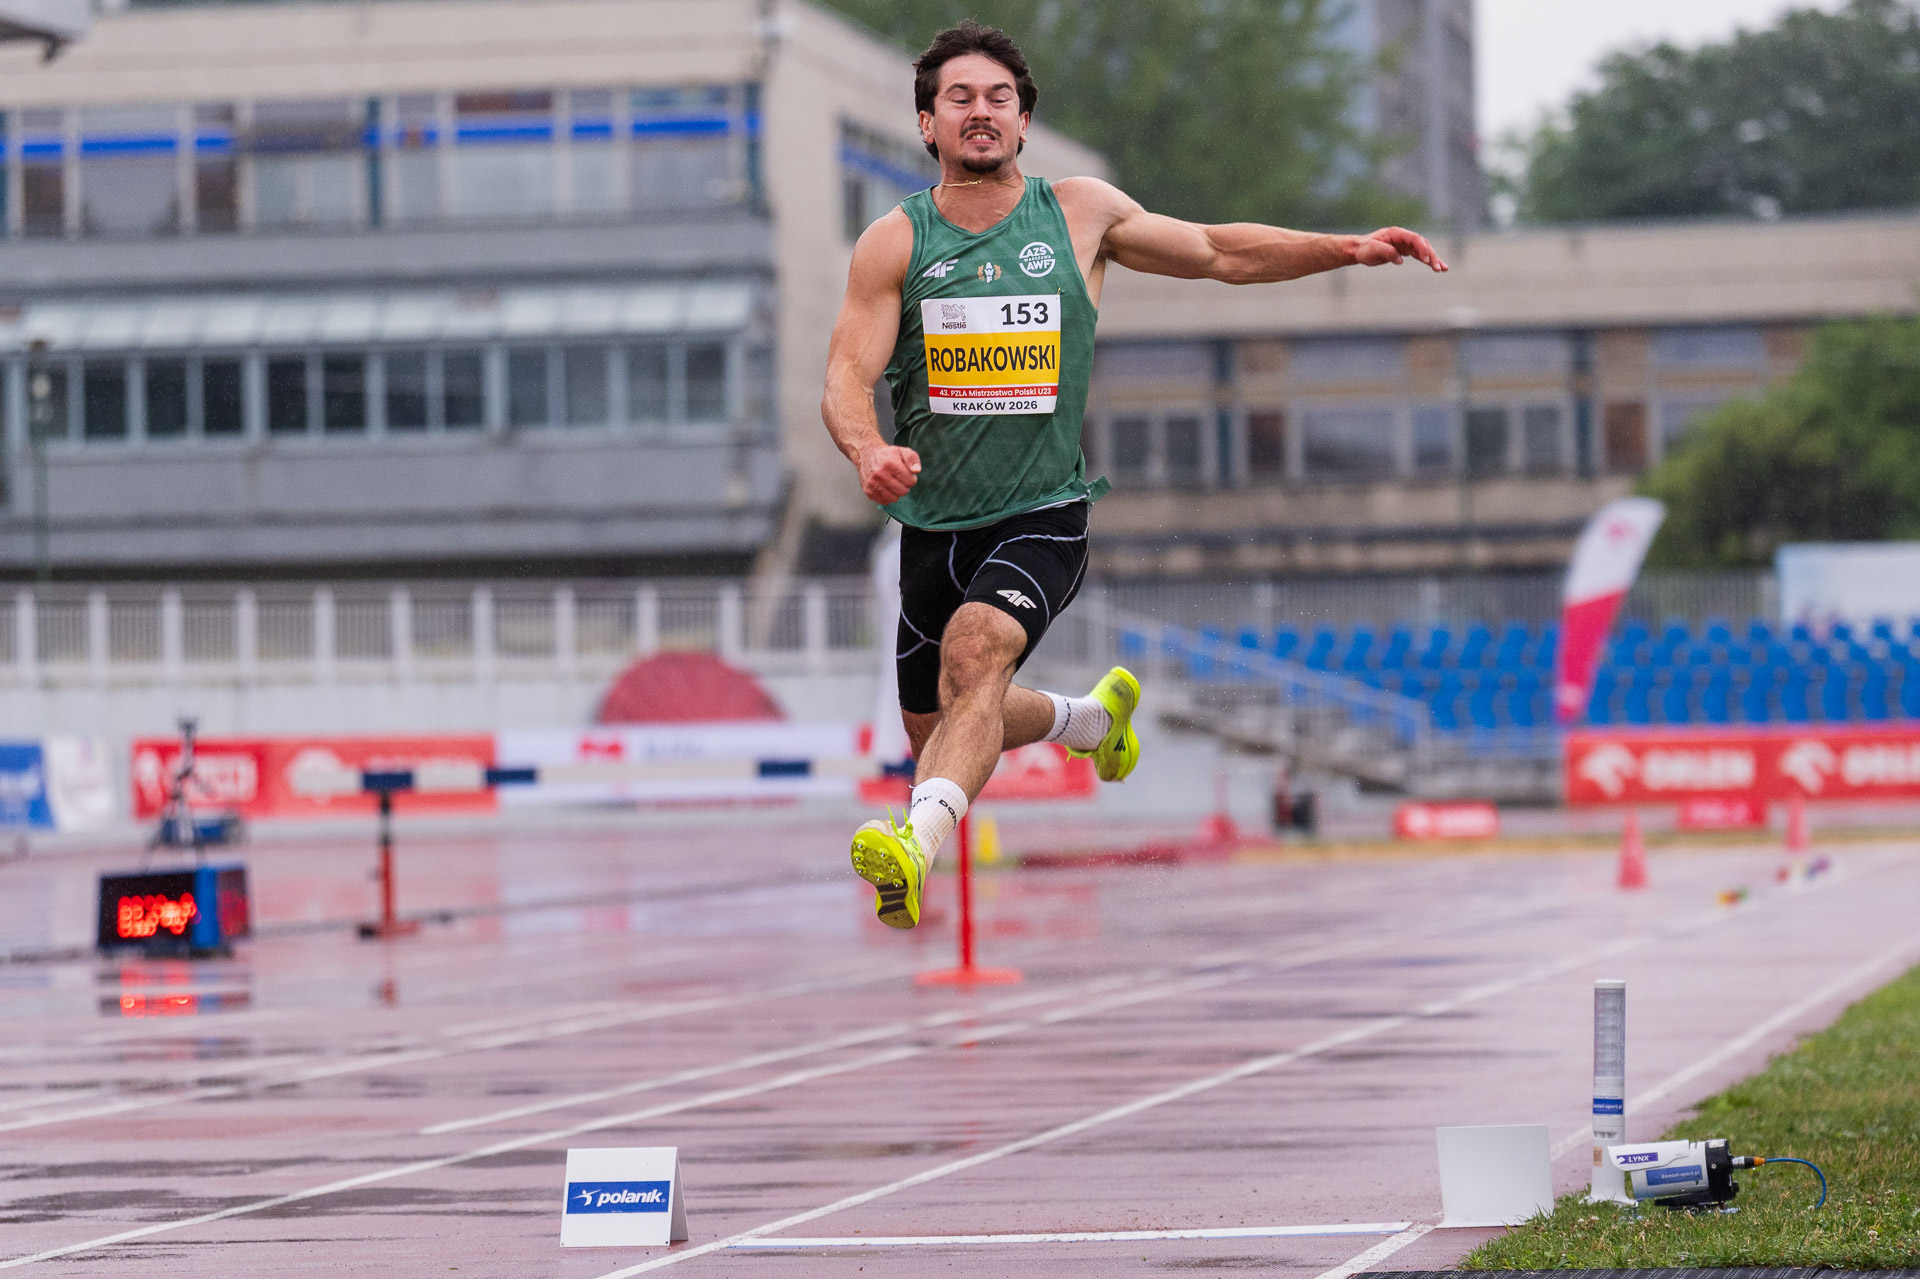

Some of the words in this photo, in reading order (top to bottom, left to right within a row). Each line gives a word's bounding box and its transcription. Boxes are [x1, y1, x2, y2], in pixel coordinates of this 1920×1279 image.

[1026, 246, 1047, 257] AZS
[922, 258, 959, 278] 4F
[1026, 259, 1051, 271] AWF
[1000, 302, 1049, 326] 153
[942, 321, 967, 330] Nestlé
[930, 344, 1056, 373] ROBAKOWSKI
[939, 389, 950, 397] 43.
[968, 389, 1013, 397] Mistrzostwa
[1014, 388, 1037, 396] Polski
[1037, 387, 1052, 395] U23
[953, 400, 1006, 411] KRAKÓW
[1008, 400, 1038, 410] 2026
[996, 589, 1038, 609] 4F
[1628, 1155, 1650, 1163] LYNX
[1660, 1169, 1700, 1179] domtel-sport.pl
[596, 1188, 663, 1208] polanik
